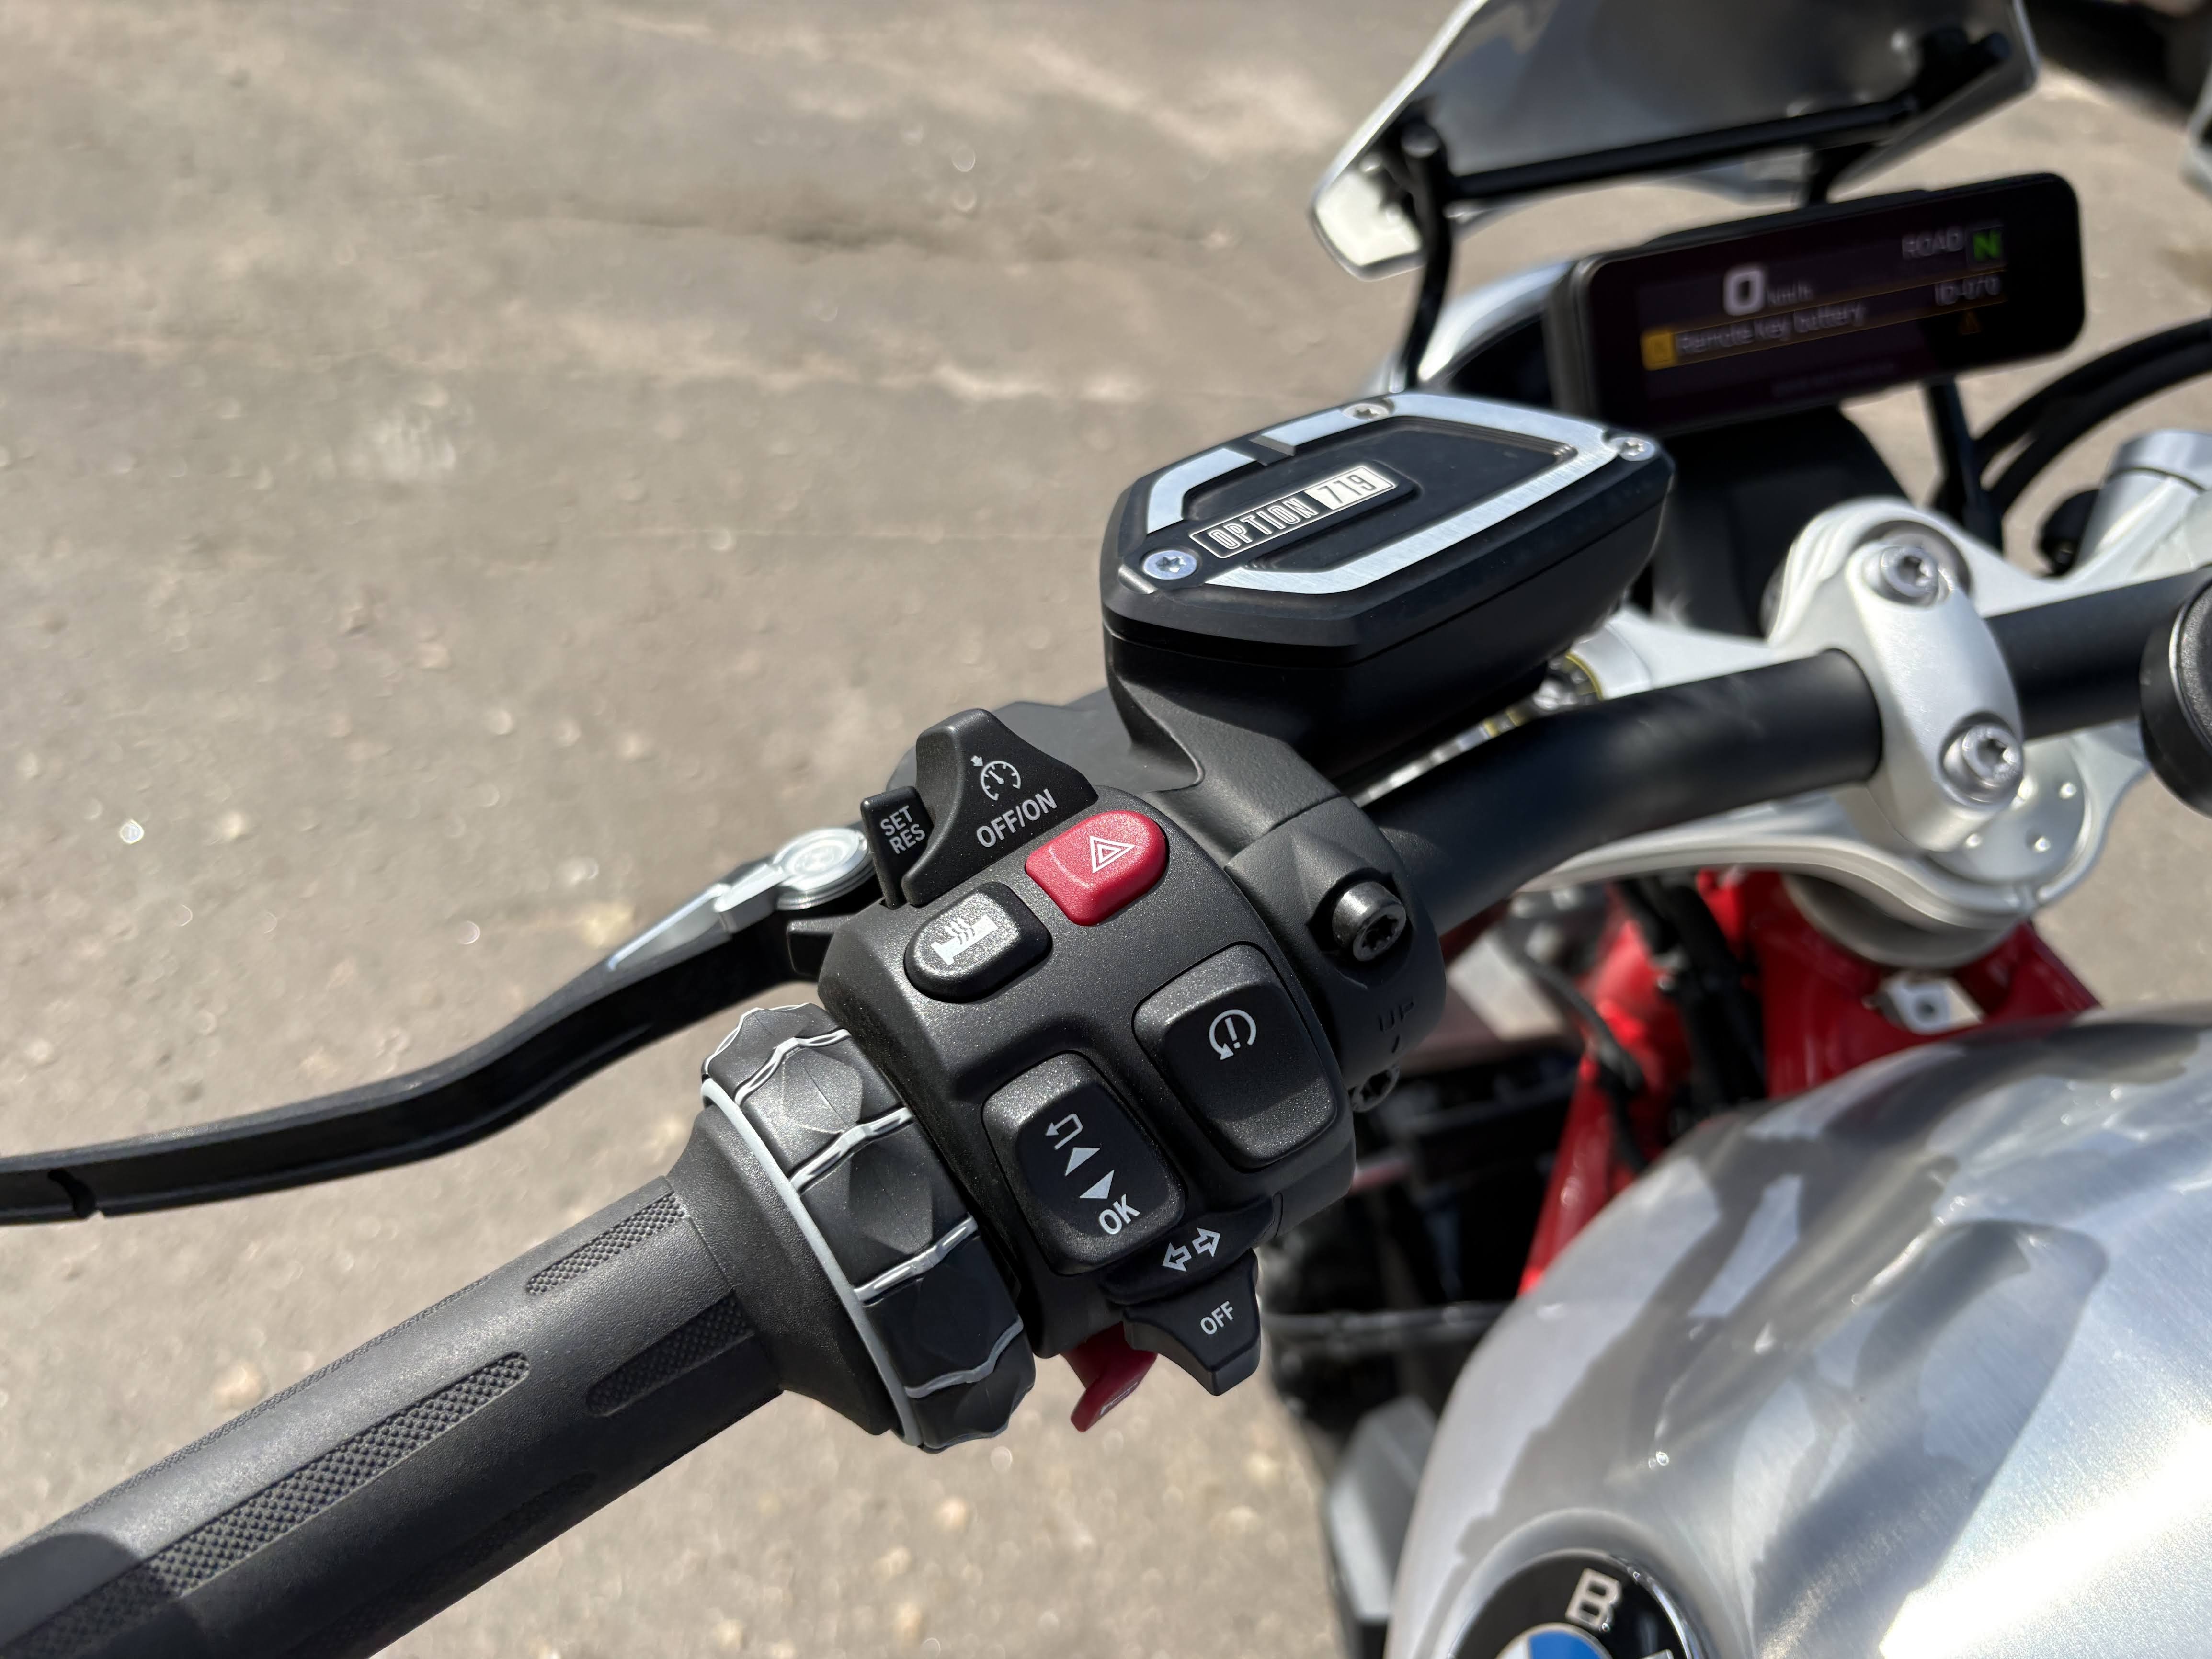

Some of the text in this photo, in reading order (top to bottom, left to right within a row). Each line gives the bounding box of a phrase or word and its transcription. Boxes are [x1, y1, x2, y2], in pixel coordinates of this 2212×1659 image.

[1901, 226, 1964, 260] ROAD
[1973, 229, 2002, 262] N
[1722, 262, 1767, 317] 0
[1676, 302, 1868, 355] Remote key battery
[1207, 473, 1376, 551] OPTION 719
[879, 805, 914, 837] SET
[976, 788, 1058, 849] OFF/ON
[888, 823, 926, 855] RES
[1098, 1193, 1141, 1235] OK
[1199, 1300, 1235, 1336] OFF
